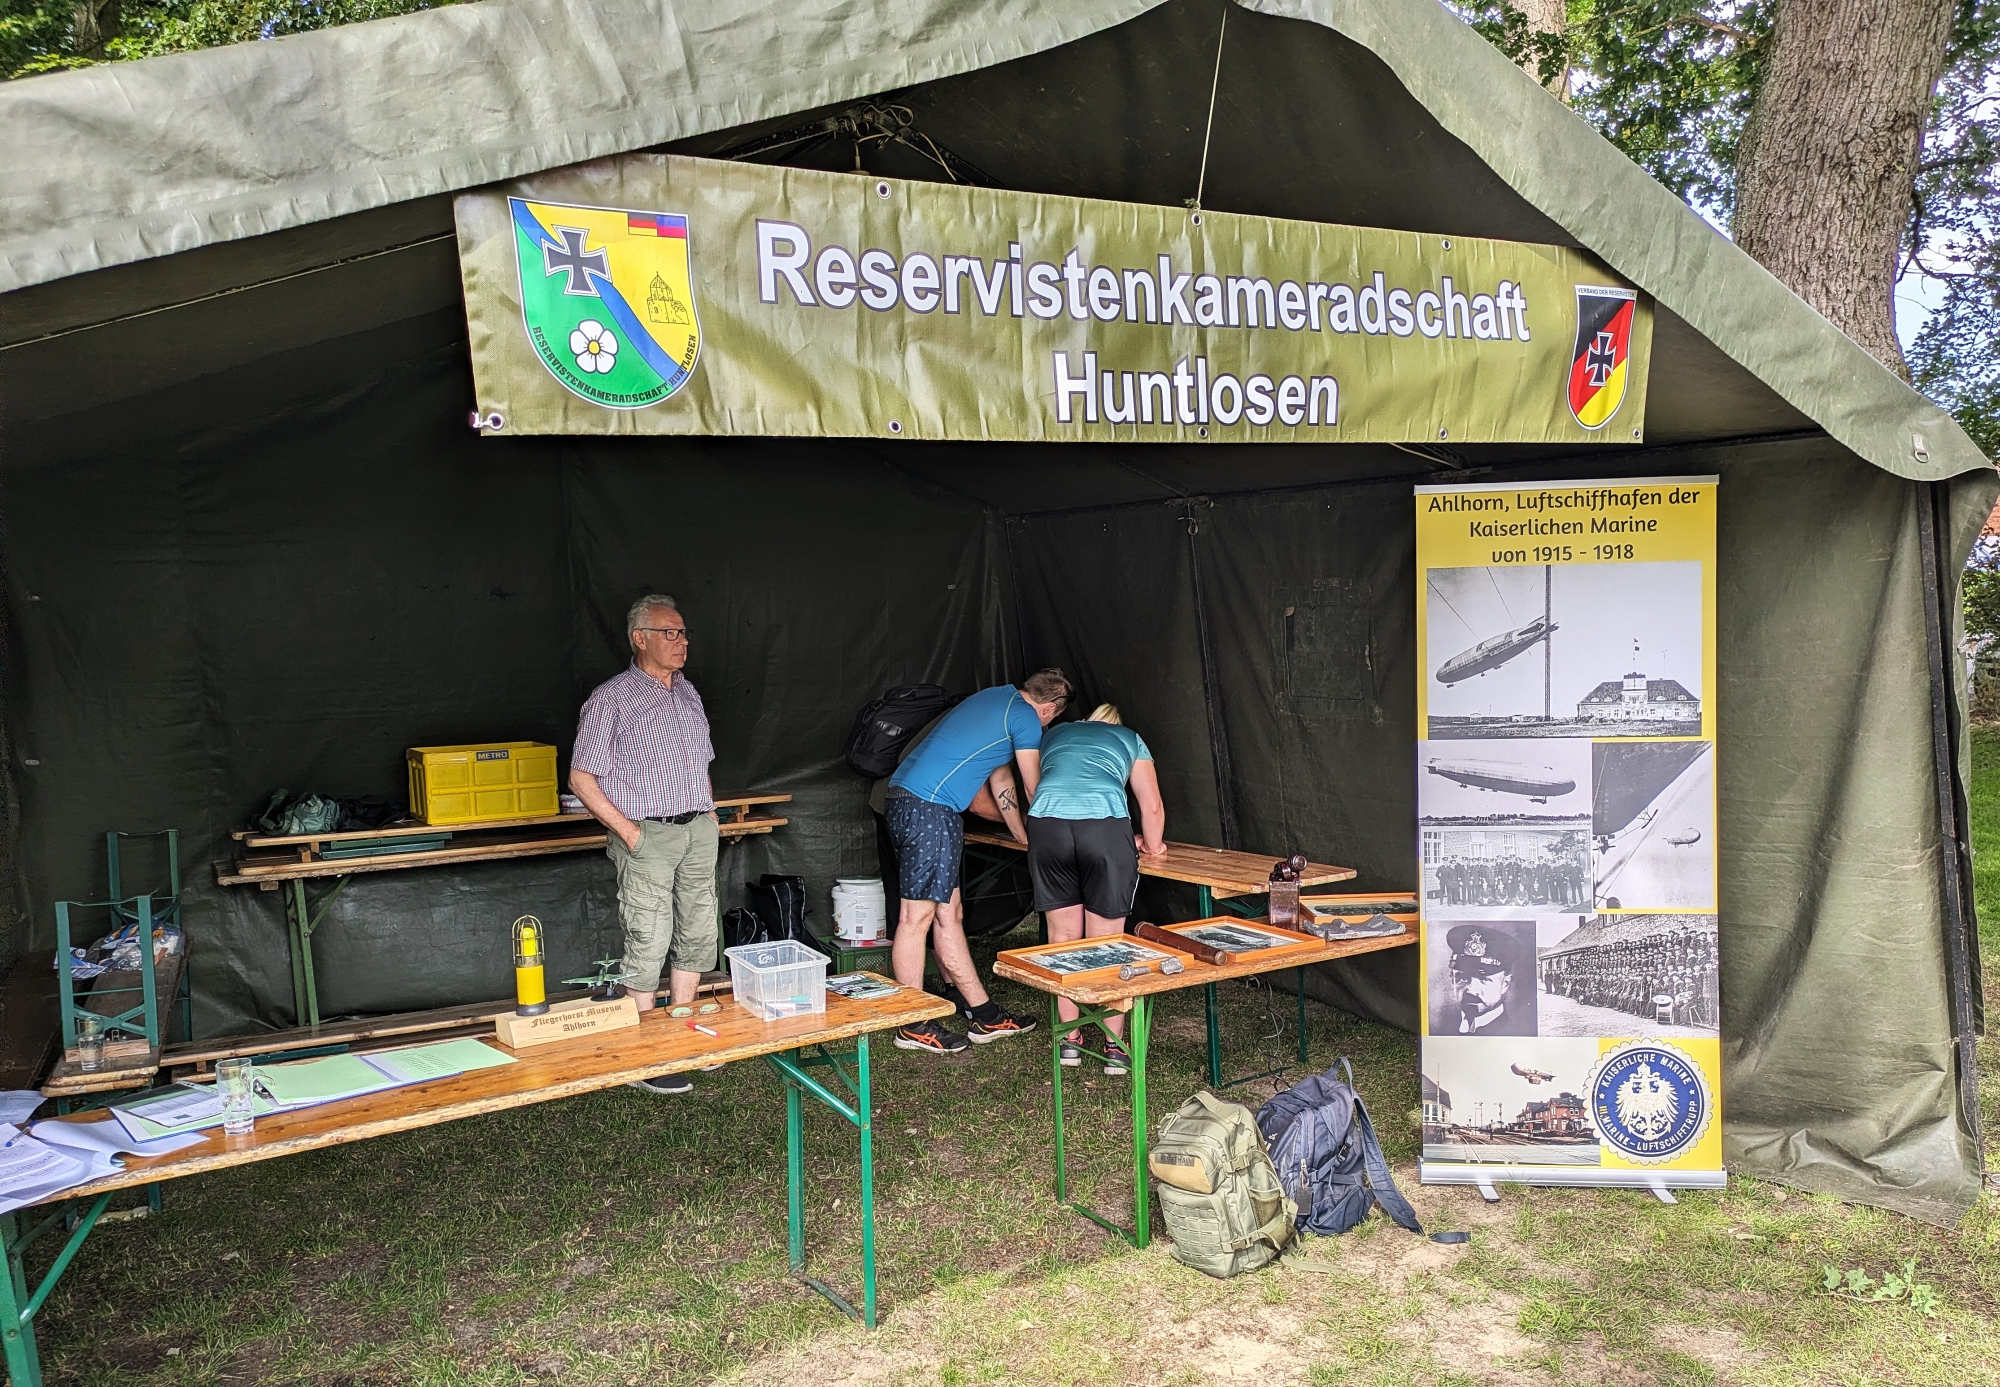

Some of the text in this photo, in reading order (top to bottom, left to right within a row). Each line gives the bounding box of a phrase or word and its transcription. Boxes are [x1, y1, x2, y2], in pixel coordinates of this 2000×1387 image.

[755, 218, 1531, 342] Reservistenkameradschaft
[532, 326, 697, 403] RESERVISTENKAMERADSCHAFT HUNTLOSEN
[1053, 350, 1339, 427] Huntlosen
[1428, 487, 1701, 513] Ahlhorn, Luftschiffhafen der
[1469, 516, 1658, 538] Kaiserlichen Marine
[1491, 548, 1527, 563] von
[1532, 546, 1573, 561] 1915
[1593, 544, 1635, 560] 1918
[478, 751, 508, 760] METRO
[531, 1004, 622, 1029] Fliegerhorst Museum
[562, 1020, 596, 1032] Ahlhorn
[1600, 1053, 1692, 1088] KAISERLICHE MARINE
